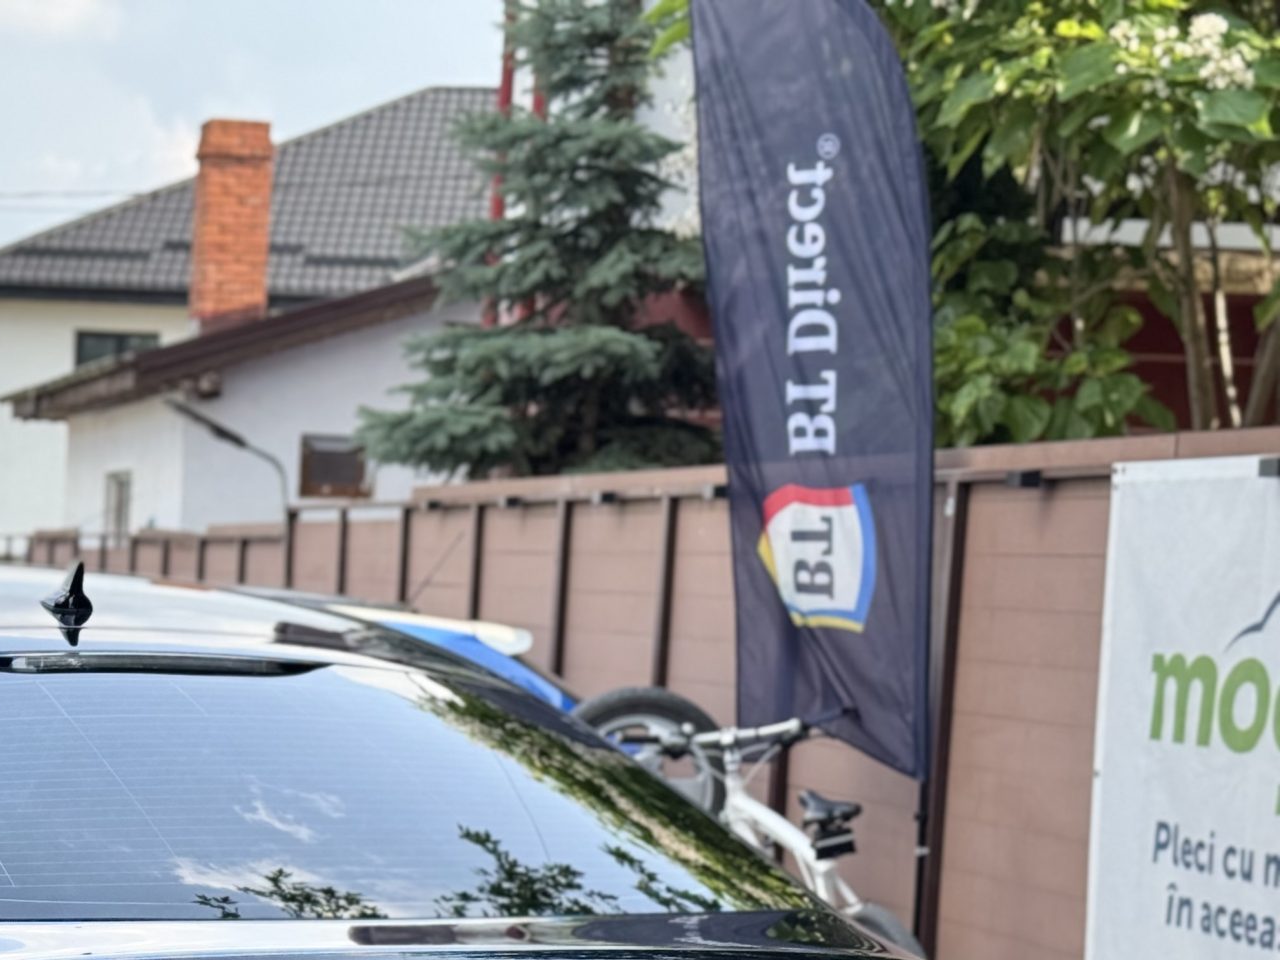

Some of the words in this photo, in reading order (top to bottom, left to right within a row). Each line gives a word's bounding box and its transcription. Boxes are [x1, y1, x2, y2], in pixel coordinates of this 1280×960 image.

[1150, 653, 1280, 754] mo
[1152, 820, 1215, 875] Pleci
[1223, 845, 1255, 882] cu
[1165, 882, 1193, 930] în
[1200, 901, 1280, 950] aceea
